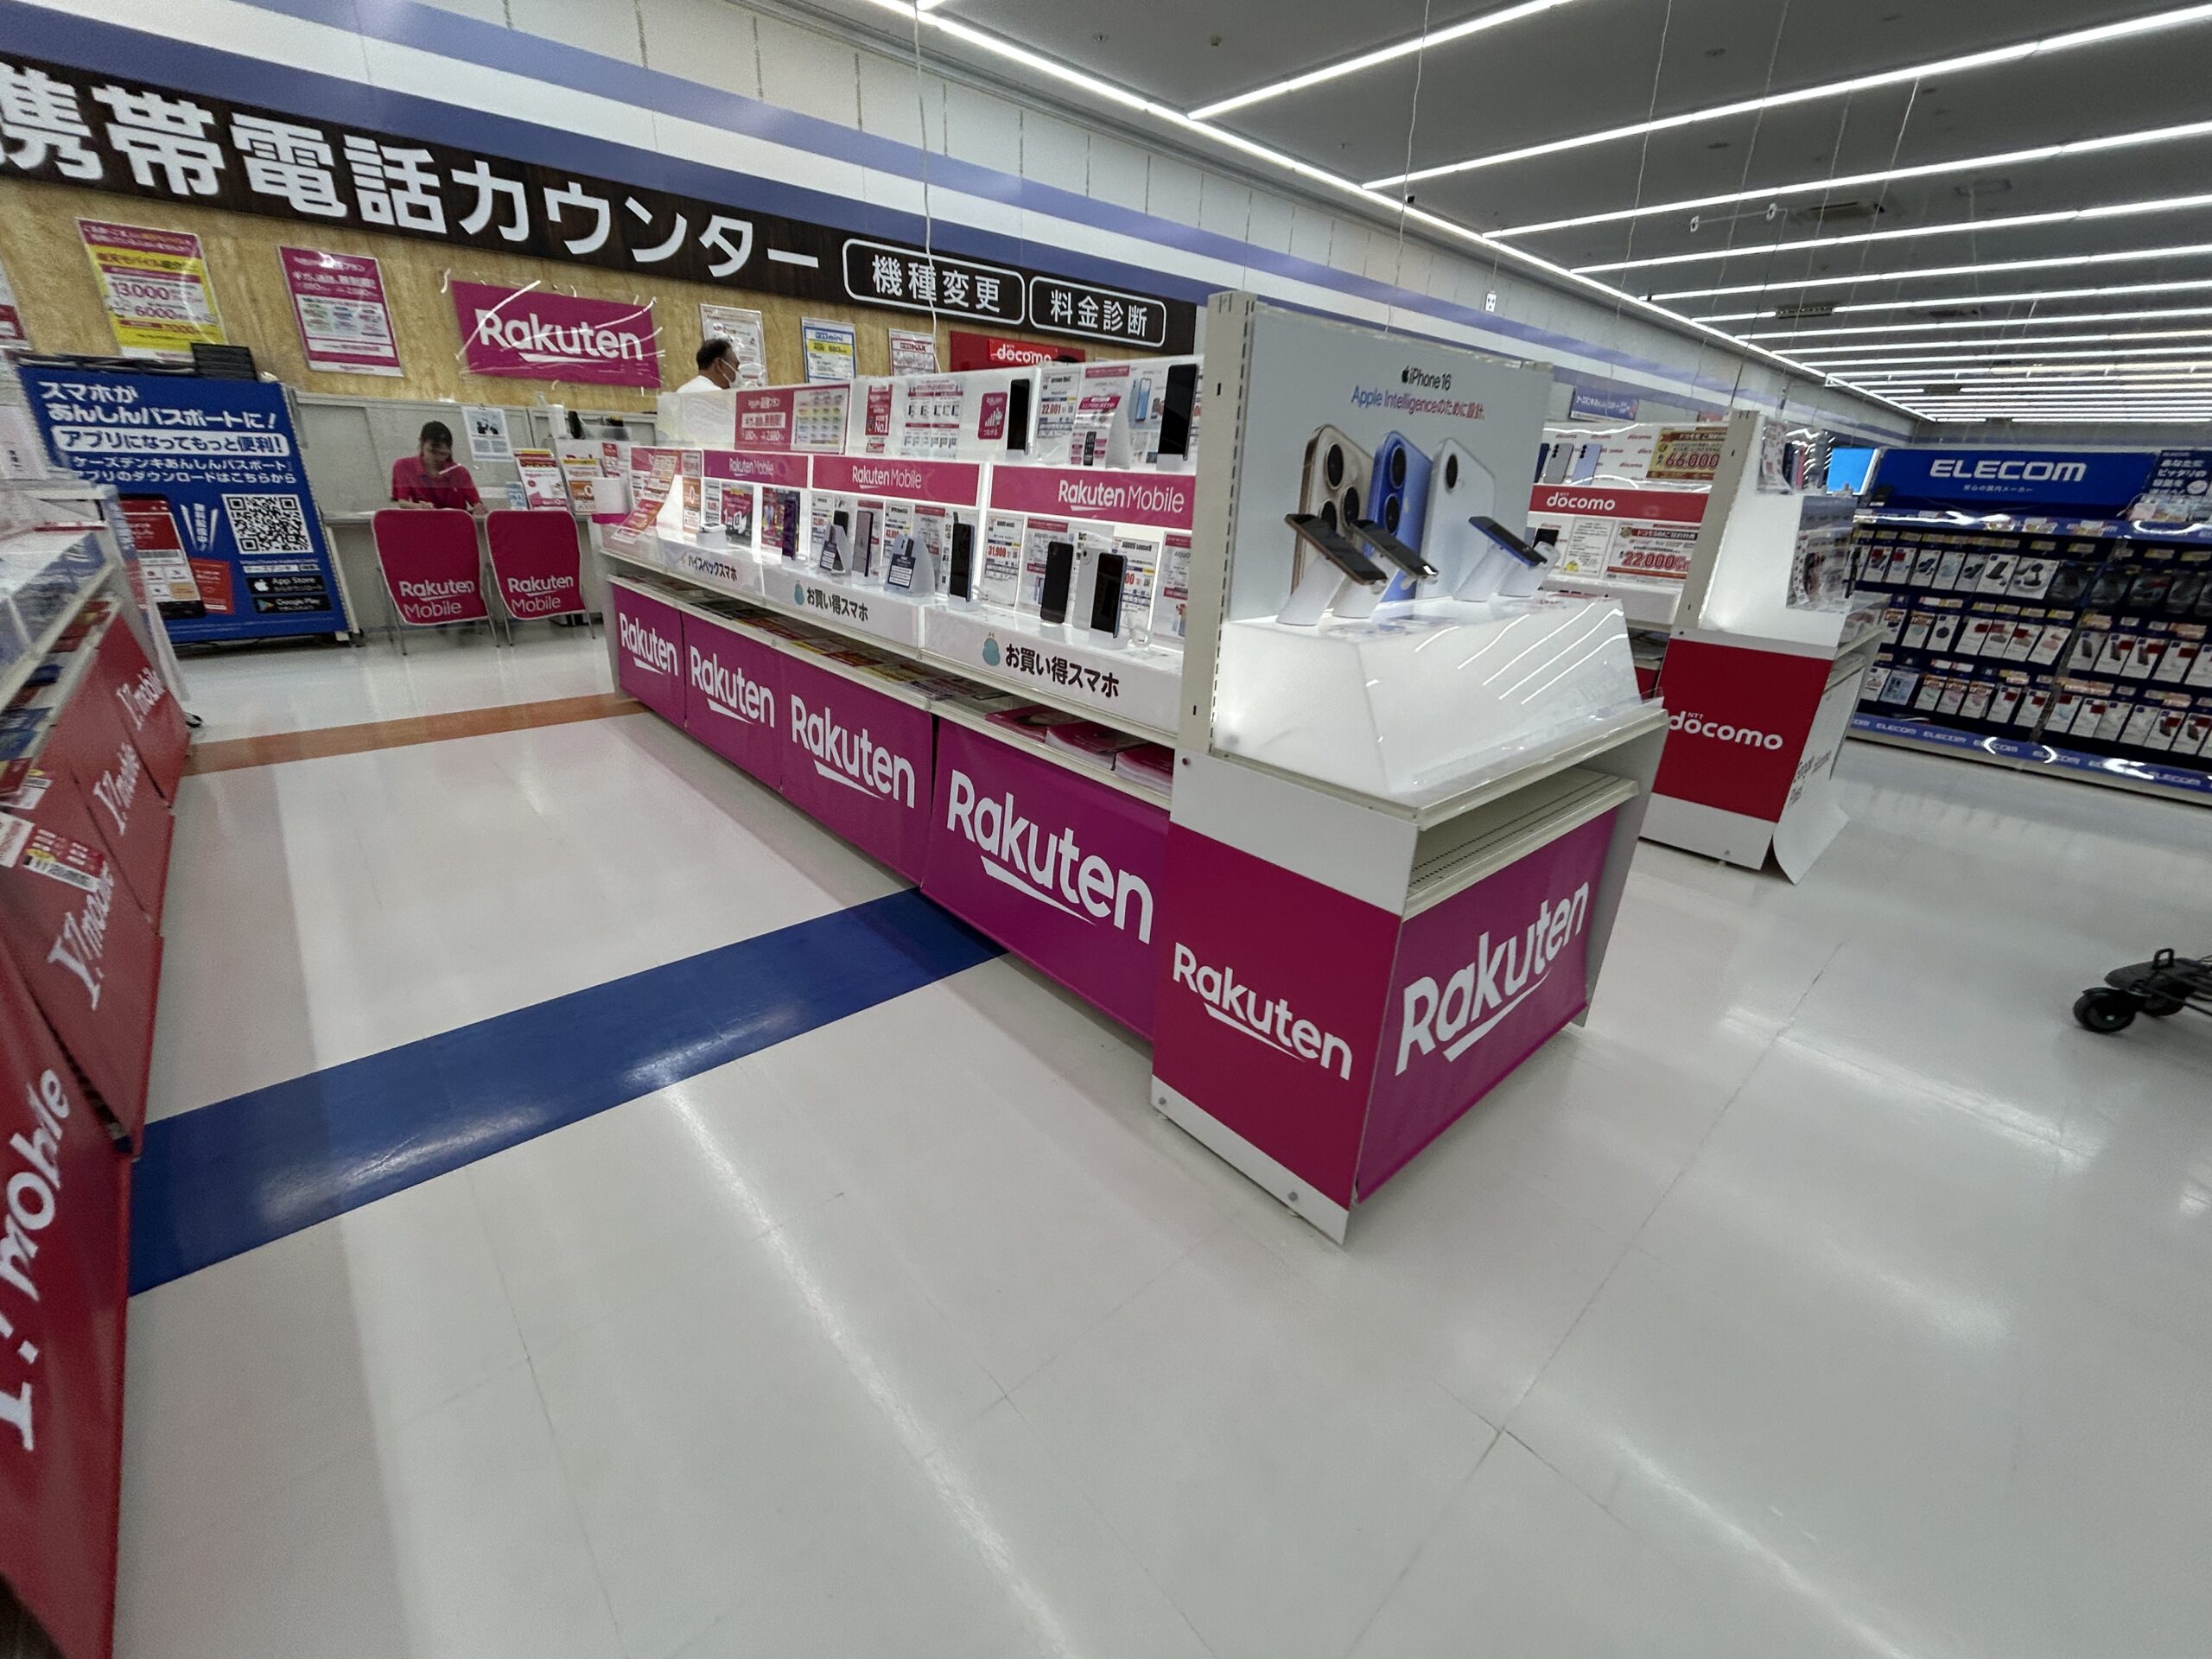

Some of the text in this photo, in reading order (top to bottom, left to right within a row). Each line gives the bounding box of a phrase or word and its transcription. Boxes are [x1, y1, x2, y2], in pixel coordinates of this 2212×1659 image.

[0, 61, 819, 278] 携帯電話カウンター
[872, 254, 1001, 314] 機種変更
[1050, 289, 1147, 337] 料金診断
[474, 308, 644, 363] Rakuten
[996, 343, 1052, 364] docomo
[38, 381, 138, 404] スマホが
[1408, 368, 1452, 391] iPhone 16
[1351, 385, 1382, 408] Apple
[729, 458, 774, 476] Rakuten Mobile
[852, 465, 922, 489] Rakuten Mobile
[1929, 459, 2088, 482] ELECOM
[1058, 480, 1185, 513] Rakuten Mobile
[1546, 491, 1616, 512] docomo
[272, 577, 290, 586] App
[398, 579, 474, 599] Rakuten
[506, 575, 574, 594] Rakuten
[403, 601, 462, 619] Mobile
[510, 594, 562, 613] Mobile
[806, 588, 868, 622] お買い得スマホ
[620, 612, 679, 677] Rakuten
[1005, 643, 1120, 699] お買い得スマホ
[690, 645, 775, 728] Rakuten
[1687, 711, 1704, 721] NTT
[1667, 710, 1783, 751] docomo
[791, 693, 916, 809] Rakuten
[946, 769, 1154, 945] Rakuten
[1395, 880, 1589, 1077] Rakuten
[1173, 942, 1353, 1081] Rakuten
